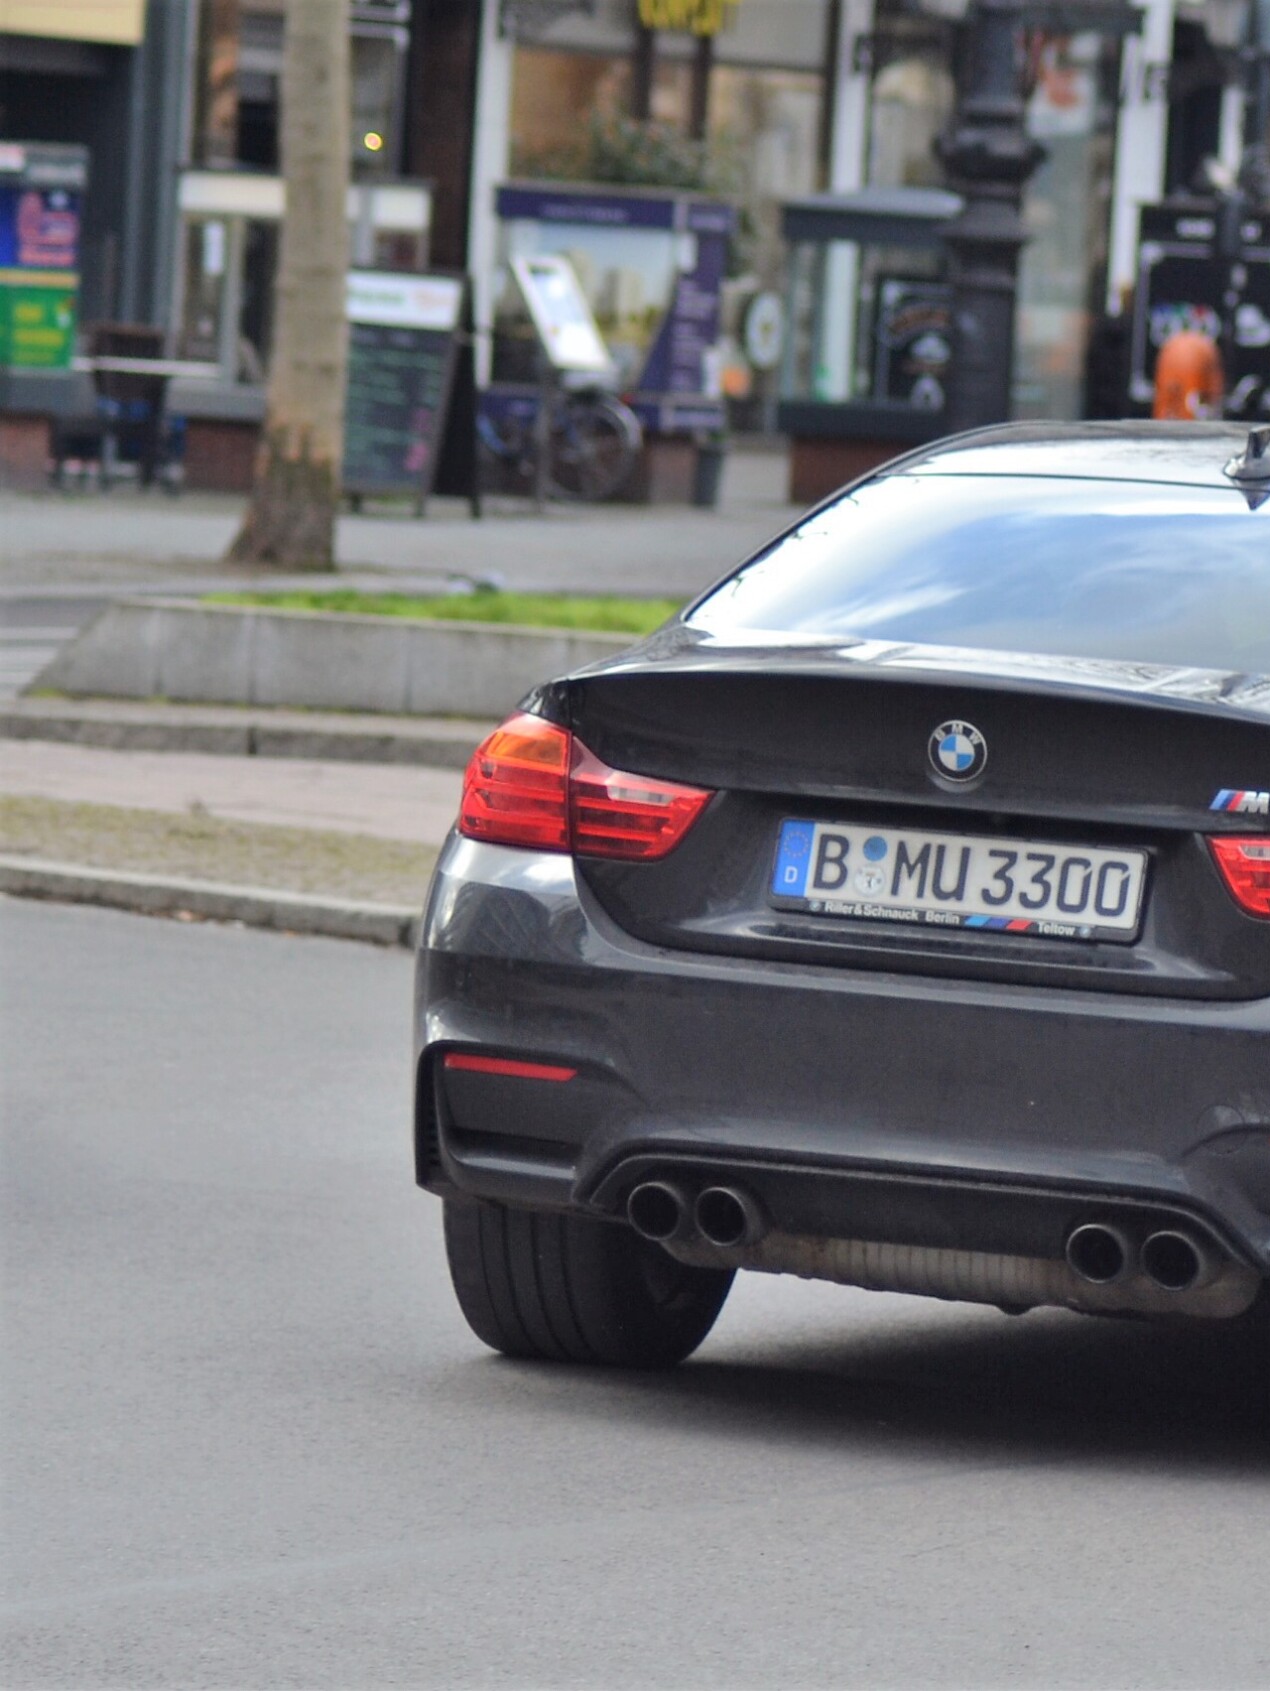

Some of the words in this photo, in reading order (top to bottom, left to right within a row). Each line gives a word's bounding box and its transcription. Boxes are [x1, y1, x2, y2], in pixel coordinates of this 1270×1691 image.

[784, 866, 798, 884] D
[813, 833, 850, 890] B
[890, 840, 971, 902] MU
[981, 849, 1131, 917] 3300
[925, 911, 960, 925] Berlin
[1038, 921, 1075, 936] Teltow
